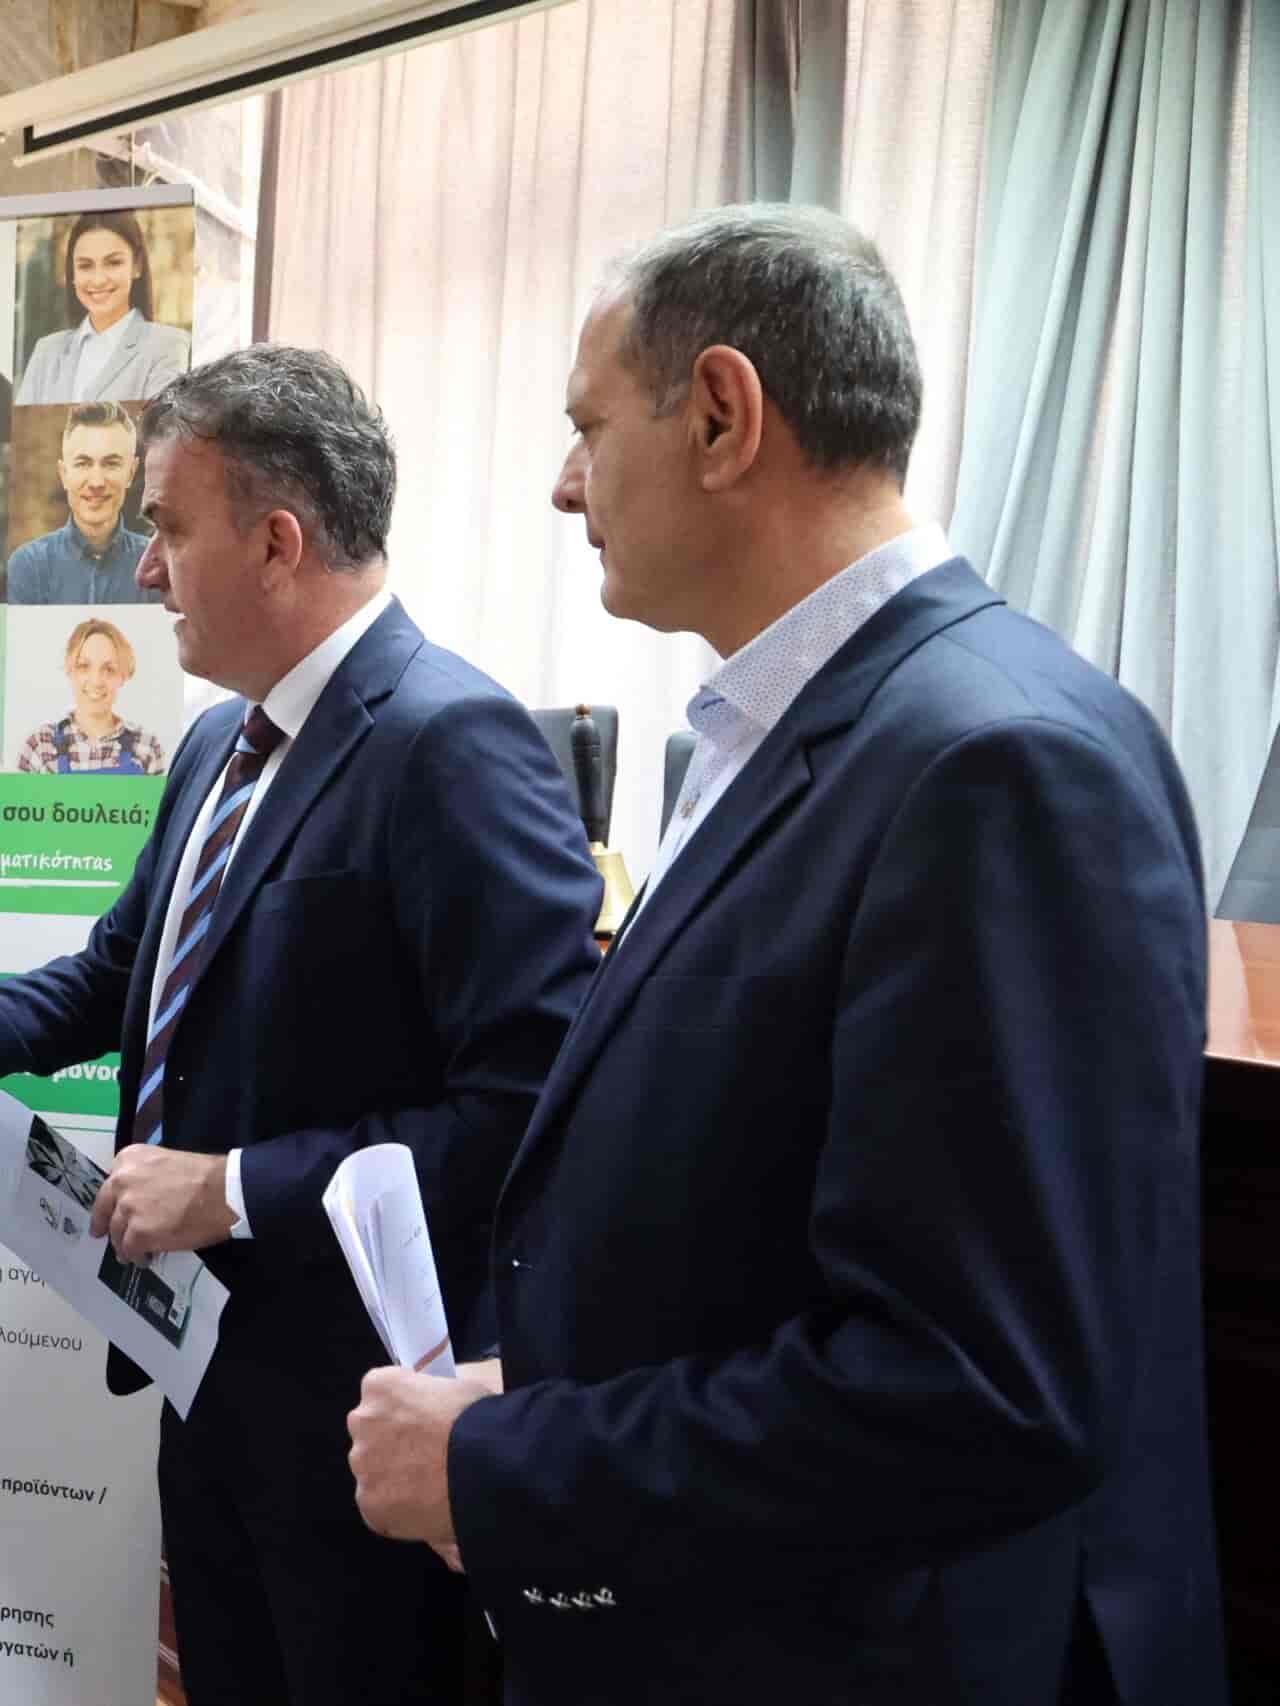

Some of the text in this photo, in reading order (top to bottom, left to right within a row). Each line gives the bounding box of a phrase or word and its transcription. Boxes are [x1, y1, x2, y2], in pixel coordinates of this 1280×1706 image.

[3, 805, 45, 822] σου
[52, 802, 150, 828] δουλειά;
[2, 1477, 95, 1502] προϊόντων
[98, 1487, 107, 1505] /
[63, 1648, 75, 1668] ή
